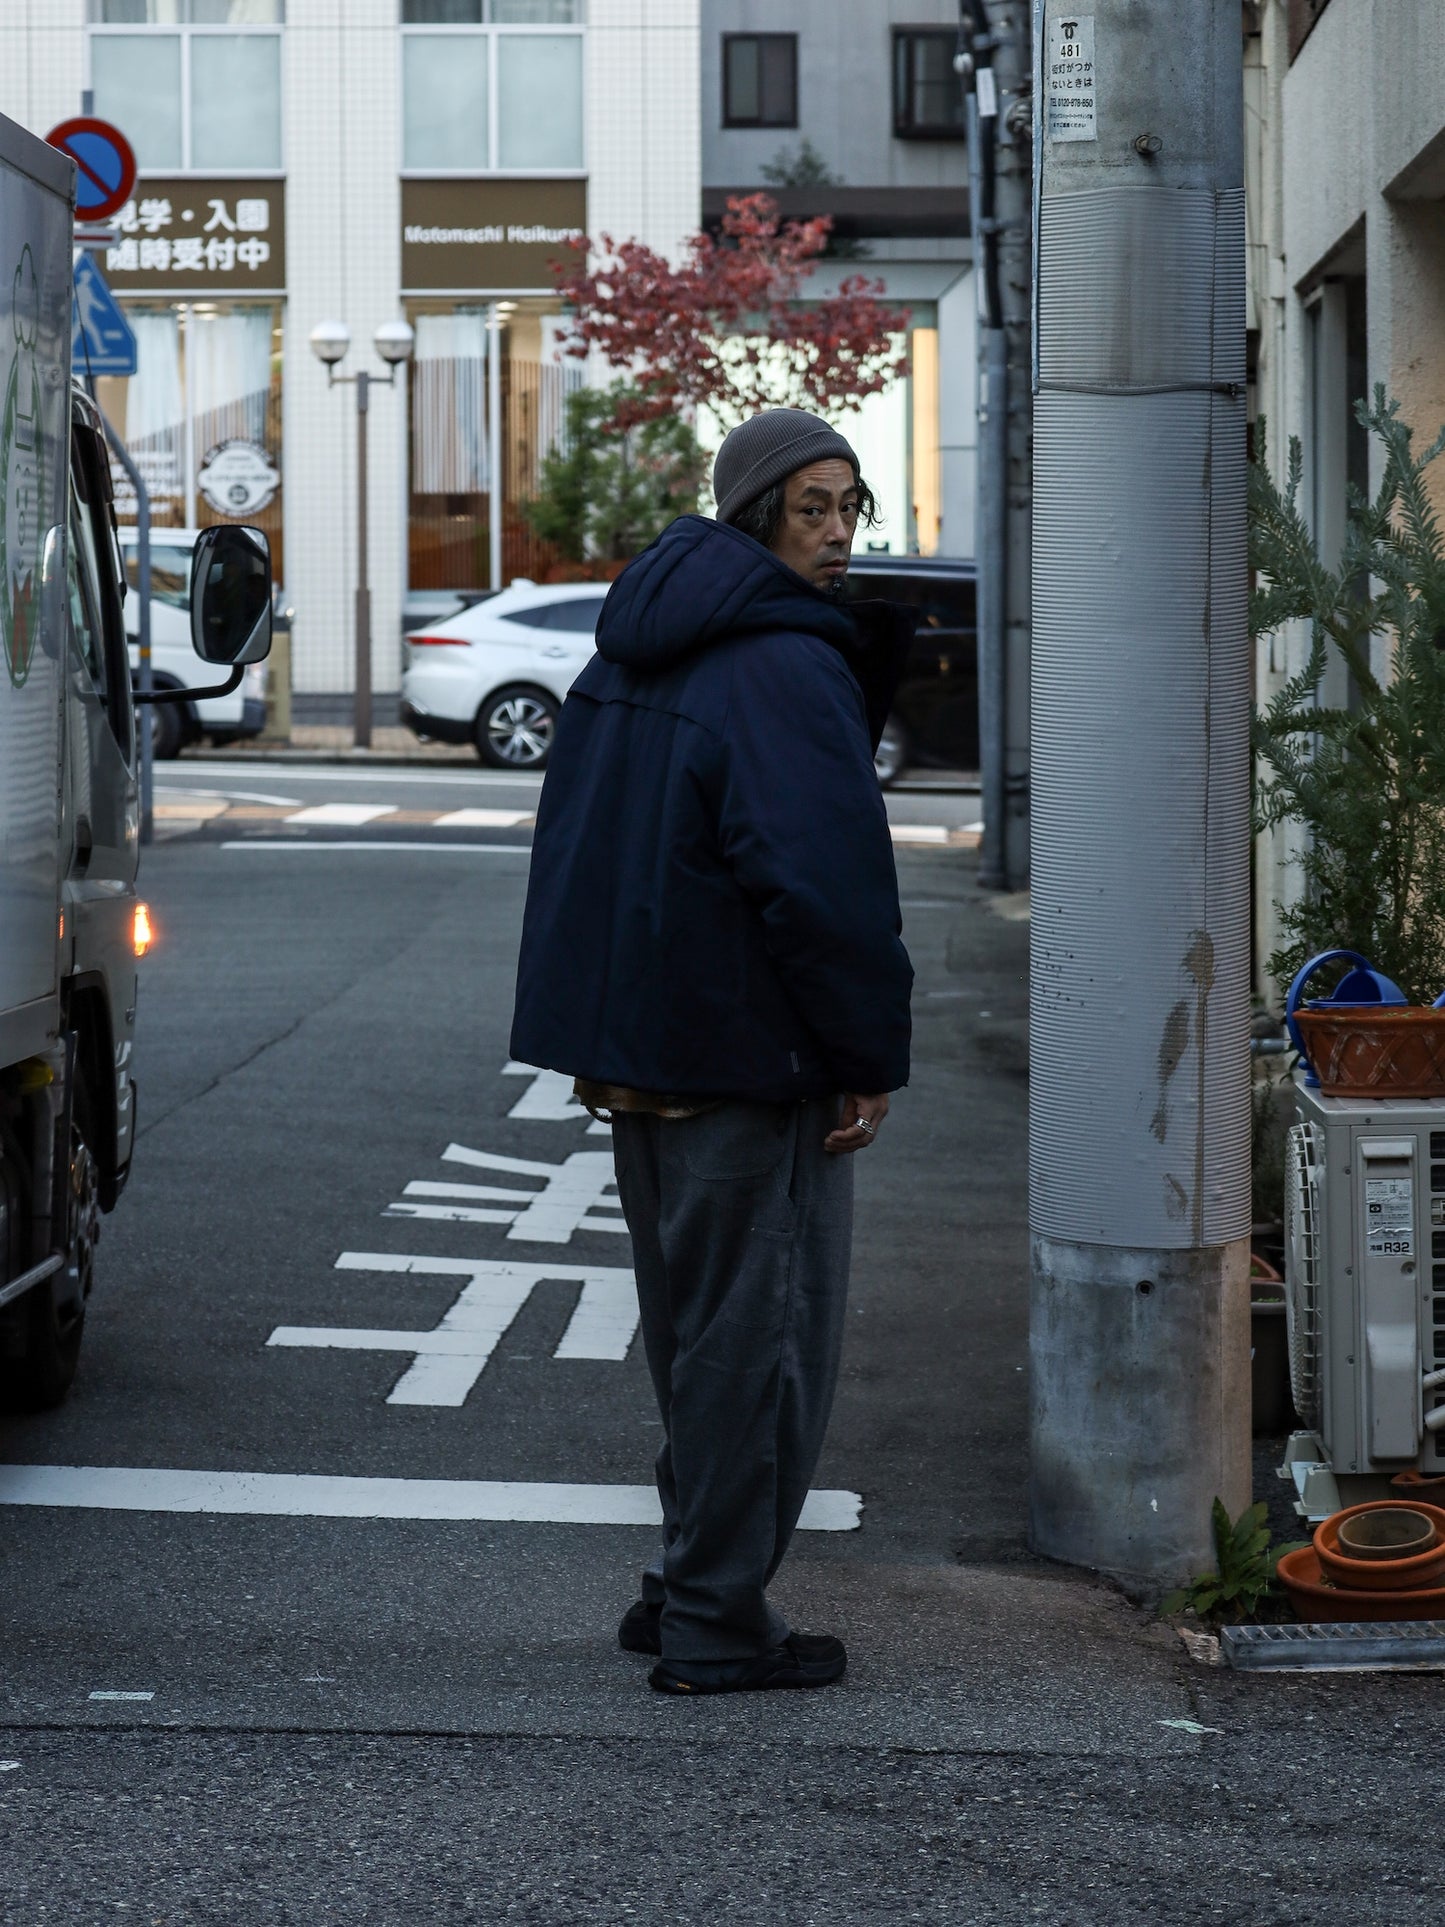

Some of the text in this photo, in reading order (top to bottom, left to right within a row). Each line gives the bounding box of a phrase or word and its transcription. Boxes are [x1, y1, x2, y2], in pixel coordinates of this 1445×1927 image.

[1061, 44, 1079, 57] 481
[1052, 62, 1092, 74] 街灯がつか
[1052, 78, 1092, 89] ないときは
[405, 225, 503, 243] Motomachi
[106, 237, 270, 271] 随時受付中
[1384, 1242, 1410, 1252] R32
